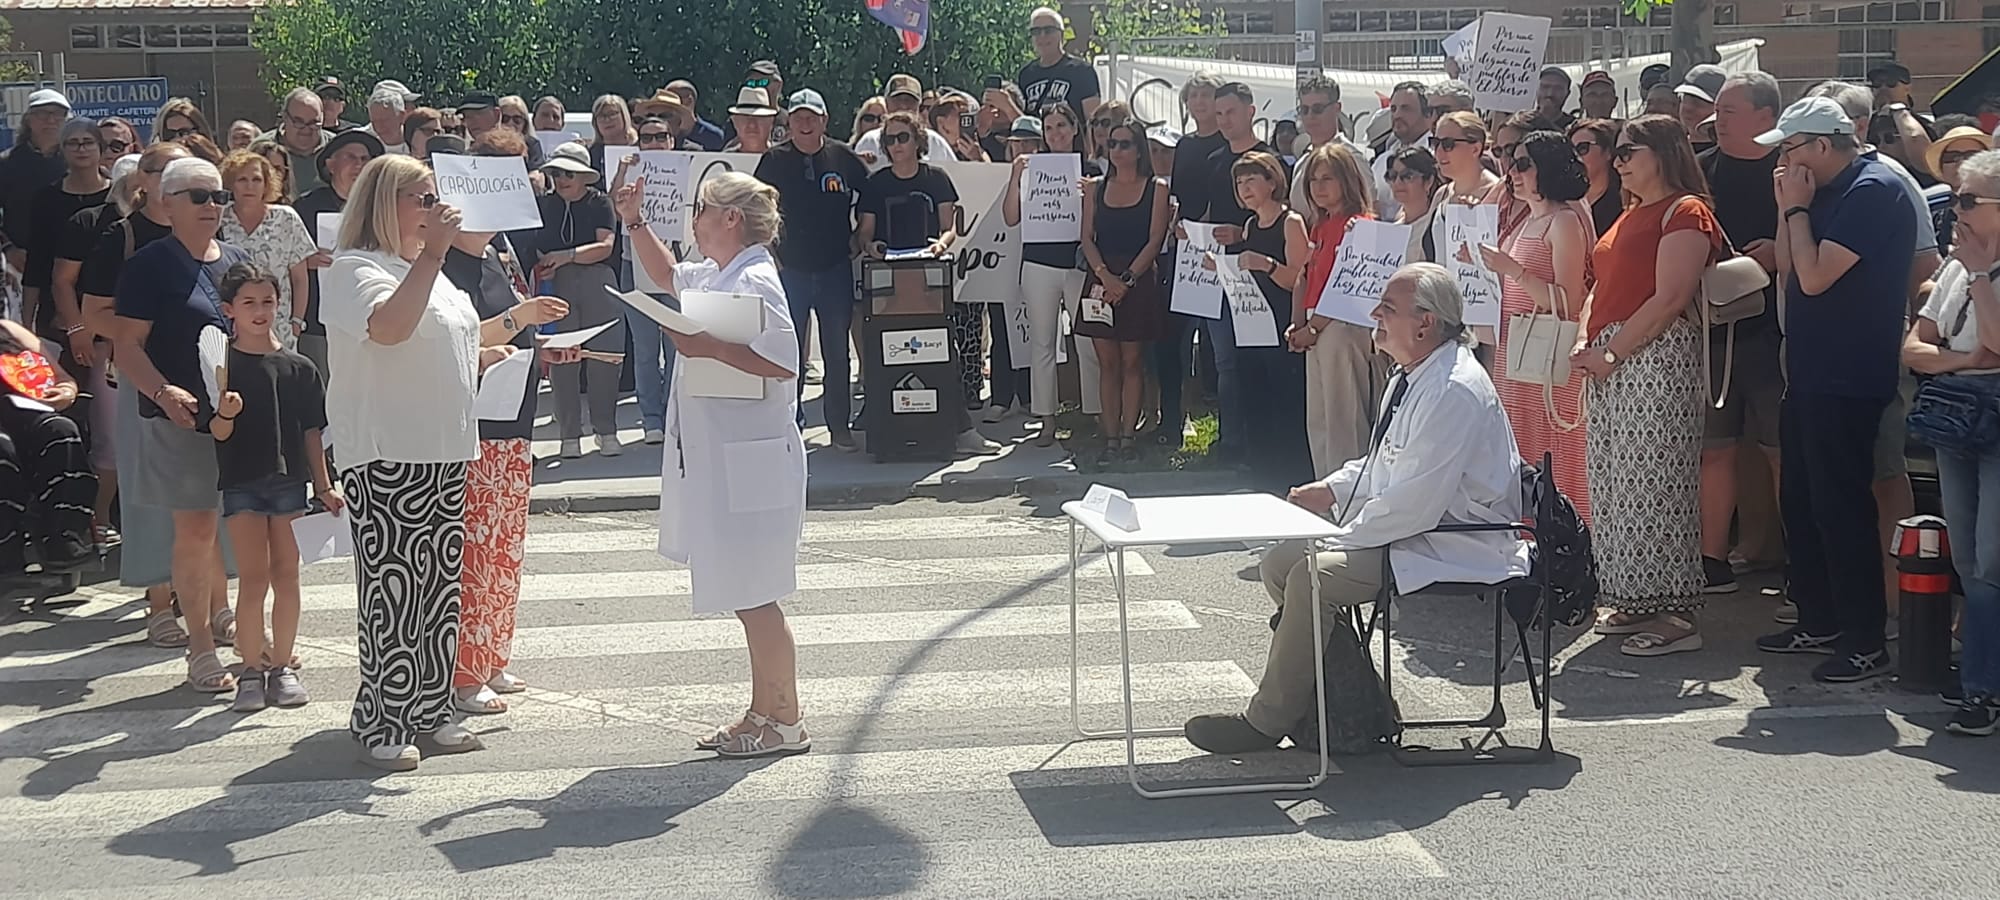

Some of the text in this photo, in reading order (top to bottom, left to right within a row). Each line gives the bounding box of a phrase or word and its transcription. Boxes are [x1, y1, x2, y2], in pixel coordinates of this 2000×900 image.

[1496, 26, 1511, 40] Por
[1518, 71, 1529, 83] de
[1477, 80, 1490, 92] El
[66, 83, 161, 105] ONTECLARO
[470, 159, 478, 170] 1
[642, 161, 658, 174] Por
[439, 174, 527, 196] CARDIOLOGÍA
[645, 173, 676, 186] tención
[1036, 171, 1067, 185] Menos
[645, 199, 664, 213] blos
[1043, 198, 1061, 209] más
[1341, 245, 1402, 268] Sin sanidad
[1333, 275, 1382, 296] hay futur
[1463, 283, 1488, 305] digna
